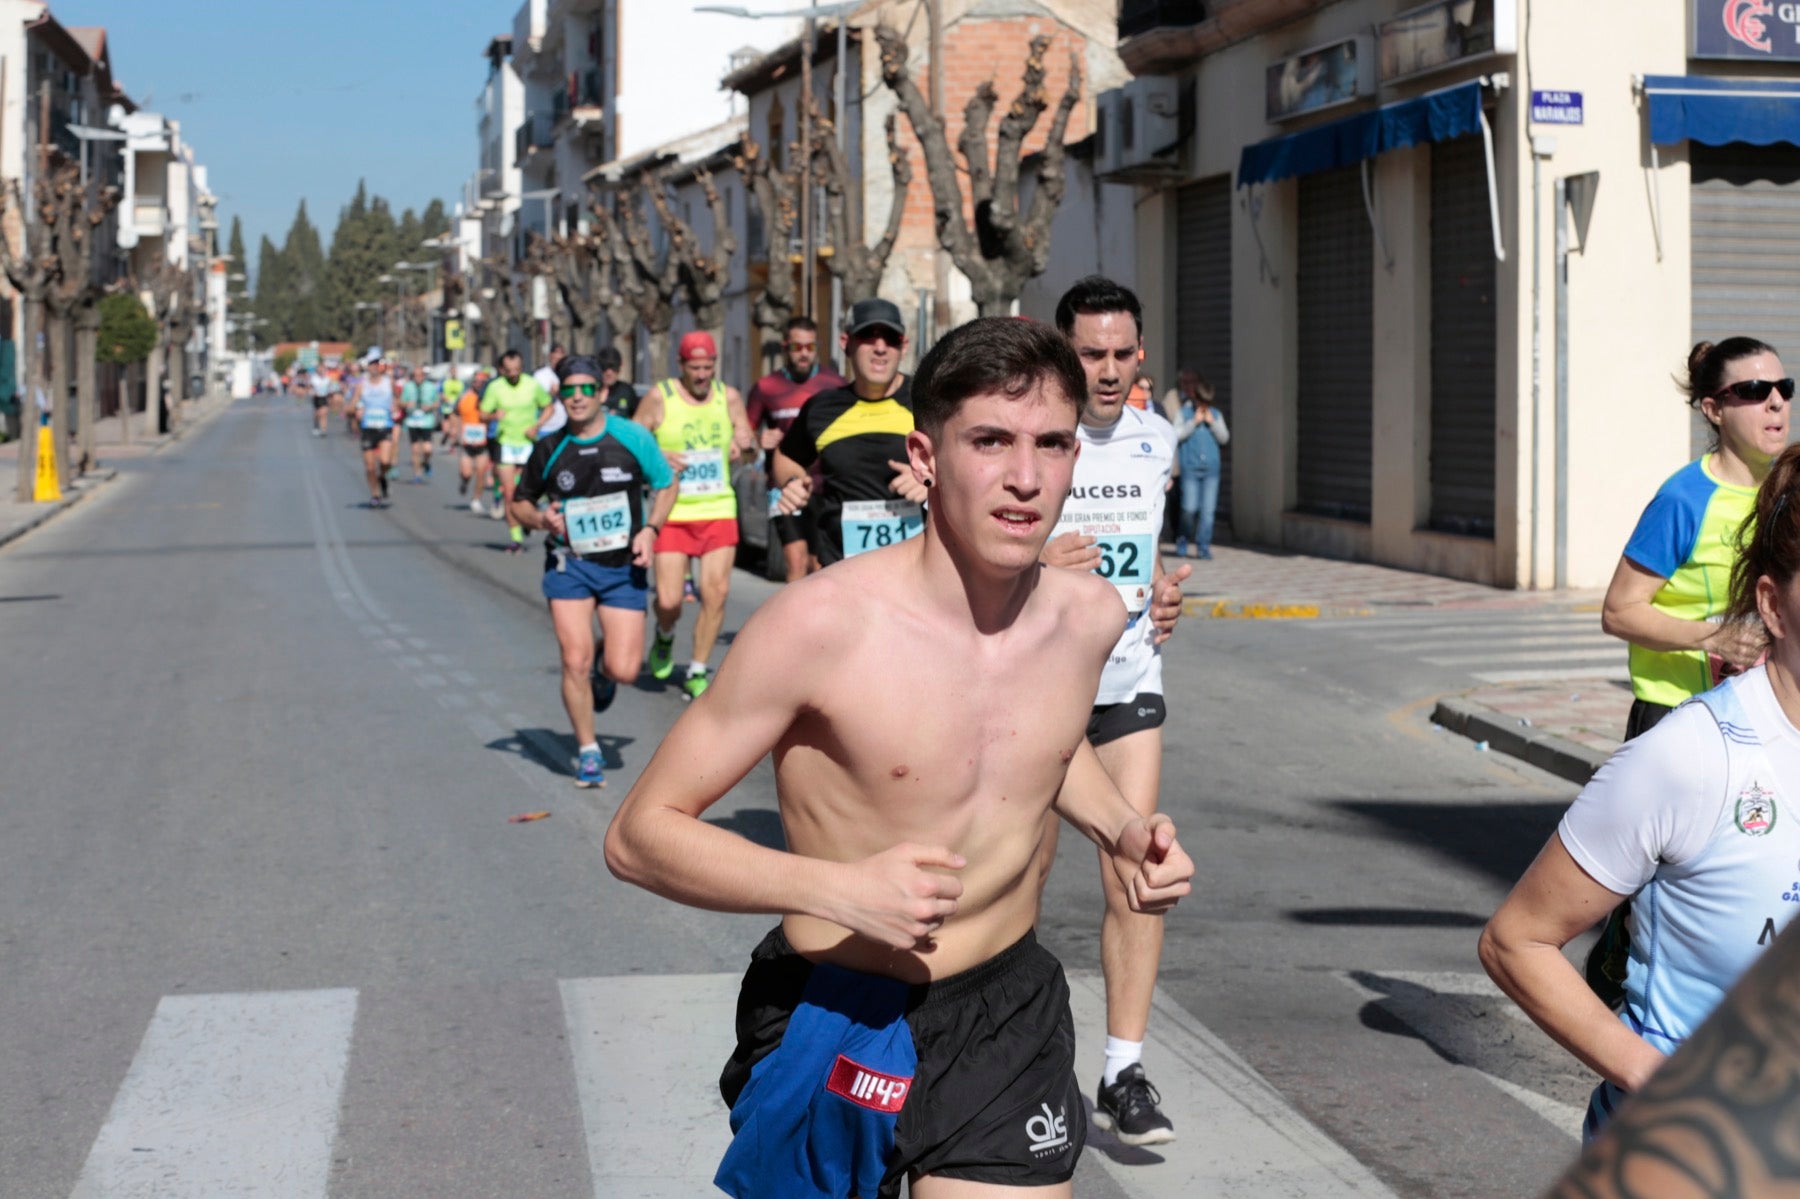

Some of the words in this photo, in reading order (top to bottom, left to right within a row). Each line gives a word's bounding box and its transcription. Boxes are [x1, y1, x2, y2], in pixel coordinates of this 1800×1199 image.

[1541, 92, 1571, 103] PLAZA
[1533, 106, 1581, 122] NARANJOS
[1067, 484, 1142, 499] ucesa
[575, 511, 625, 534] 1162
[1074, 513, 1091, 522] GRAN
[1092, 512, 1115, 521] PREMIO
[1116, 512, 1125, 521] DE
[1127, 511, 1148, 521] FONDO
[857, 522, 906, 549] 781
[850, 1070, 907, 1105] chill
